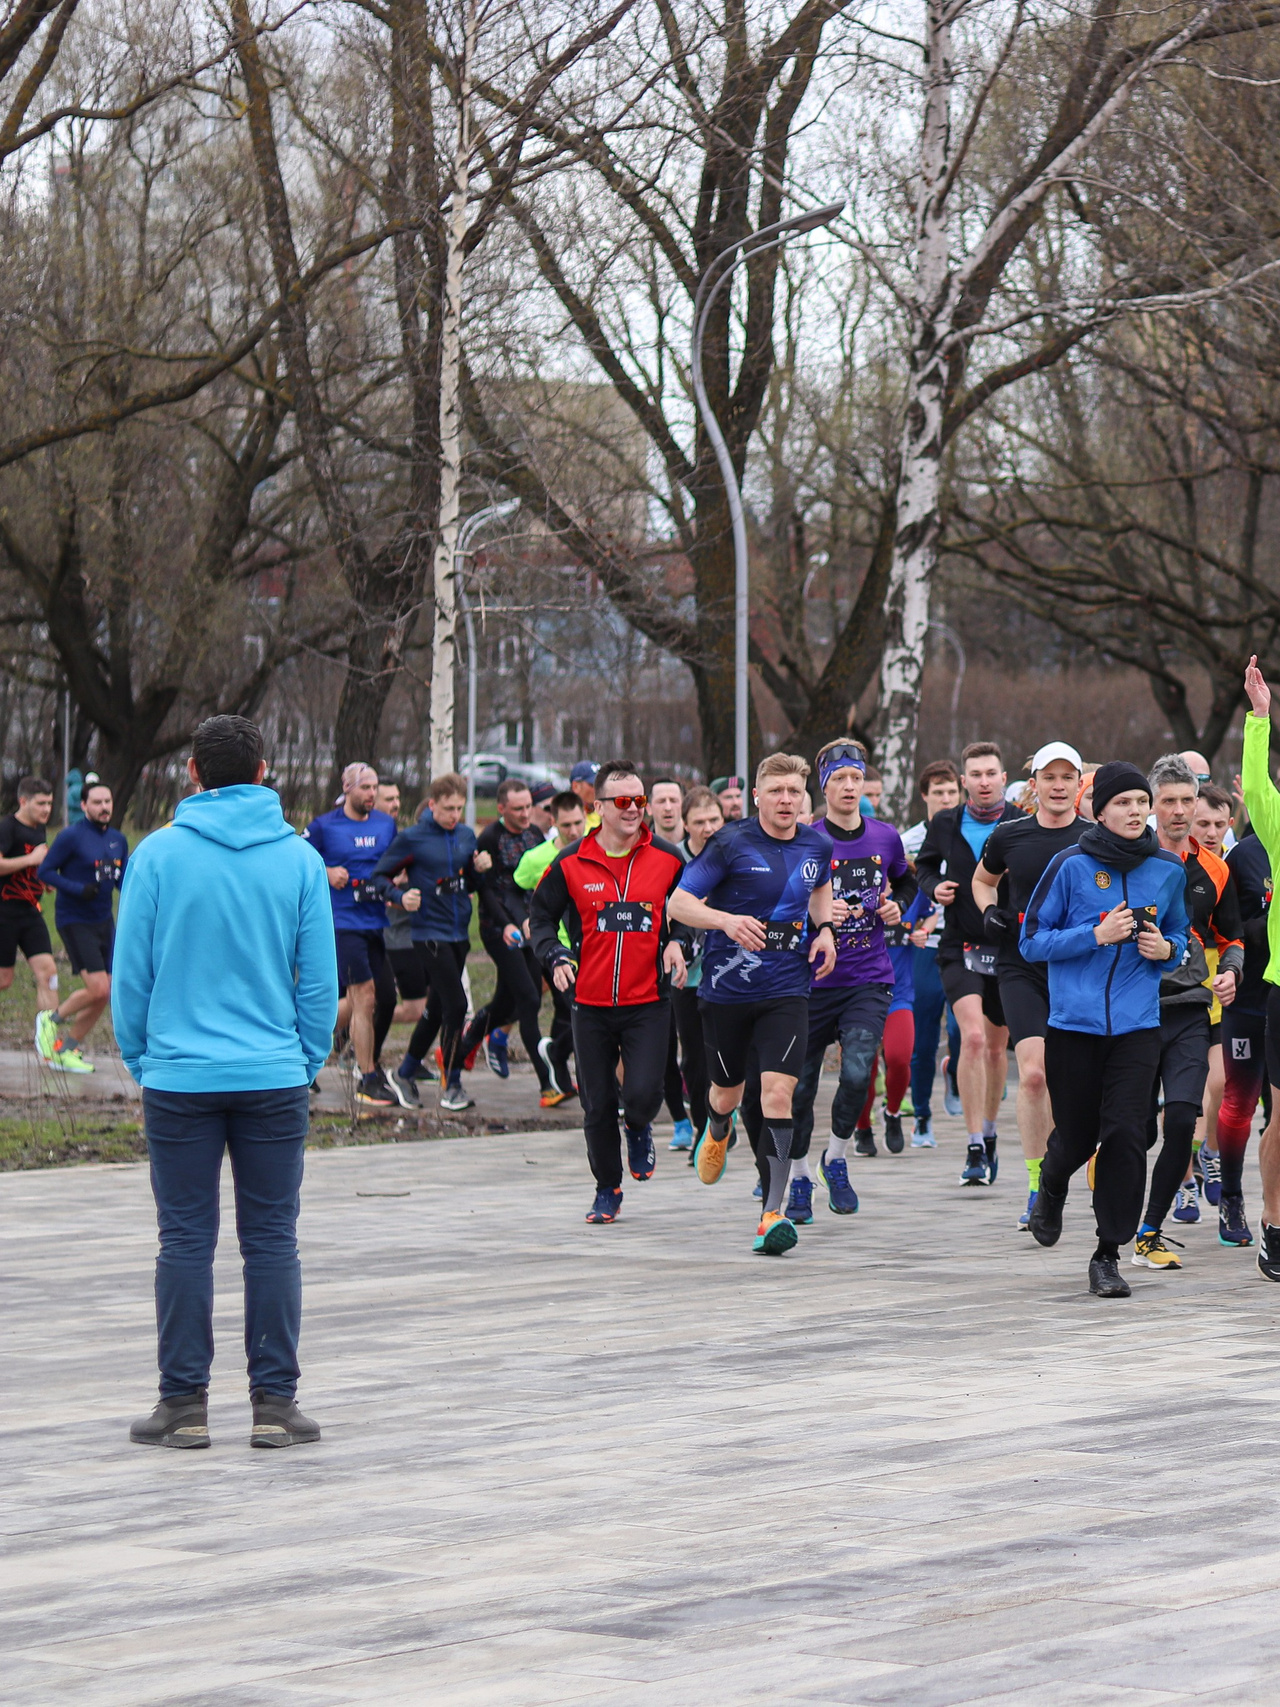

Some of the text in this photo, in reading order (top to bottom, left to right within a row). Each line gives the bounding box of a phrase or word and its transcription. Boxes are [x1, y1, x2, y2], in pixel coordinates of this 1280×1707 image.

[851, 867, 867, 877] 105
[616, 911, 633, 921] 068
[768, 931, 785, 940] 057
[980, 954, 995, 963] 137
